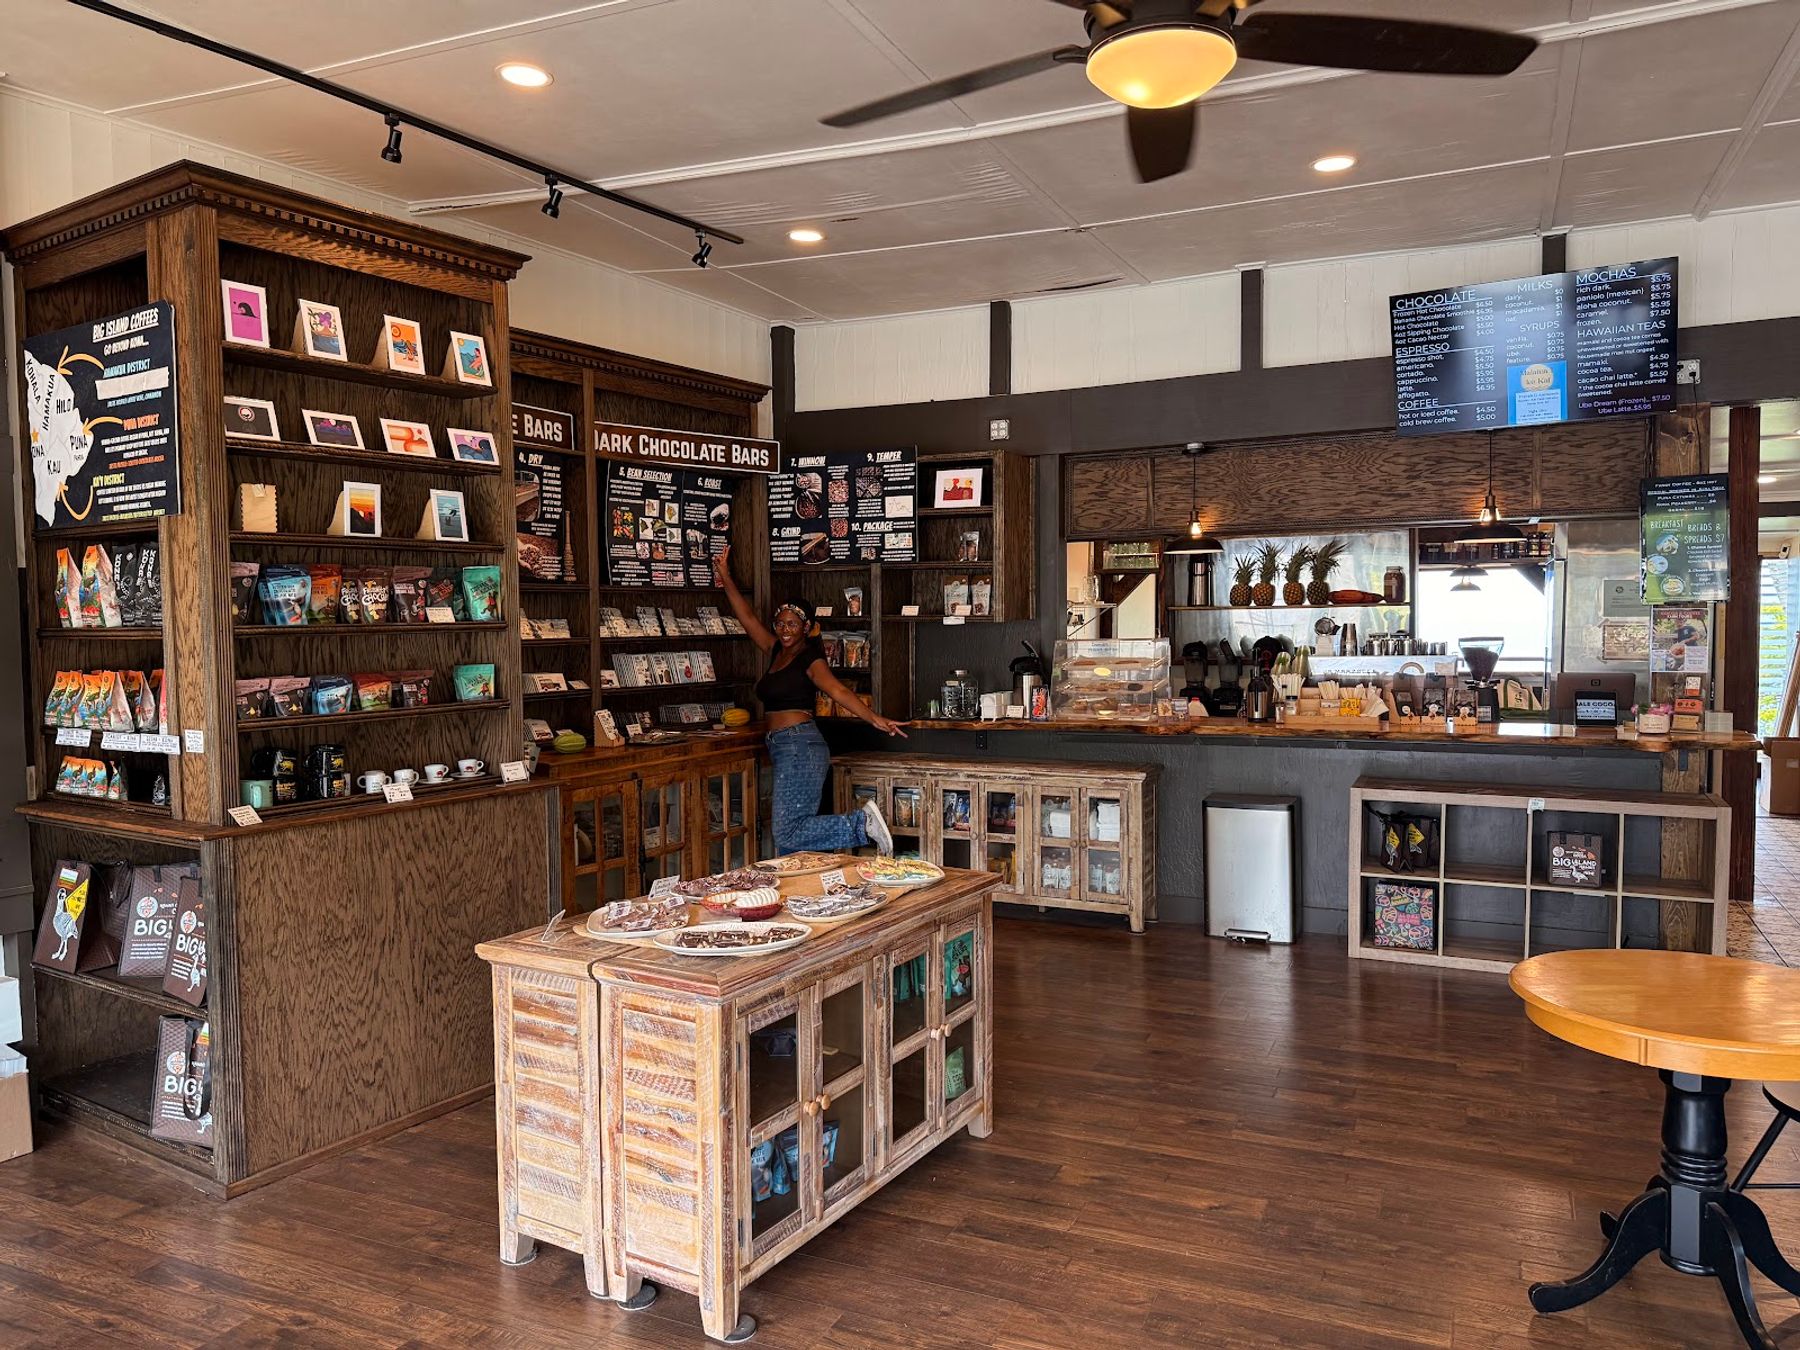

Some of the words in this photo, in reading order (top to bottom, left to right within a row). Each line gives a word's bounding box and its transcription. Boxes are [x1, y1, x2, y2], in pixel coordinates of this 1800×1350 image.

[1576, 267, 1636, 284] MOCHAS
[1518, 280, 1553, 293] MILKS
[1607, 288, 1643, 299] (mexican)
[1396, 290, 1476, 309] CHOCOLATE
[1599, 299, 1632, 307] coconut.
[93, 323, 104, 339] BIG
[106, 317, 129, 336] ISLAND
[130, 308, 159, 330] COFFEES
[1520, 321, 1559, 332] SYRUPS
[1578, 325, 1634, 338] HAWAIIAN
[1637, 320, 1666, 330] TEAS
[1396, 342, 1449, 356] ESPRESSO
[26, 359, 41, 404] KOHALA
[42, 374, 55, 430] HAMAKUA
[56, 399, 71, 414] HILO
[1398, 398, 1439, 410] COFFEE
[524, 413, 562, 442] BARS
[70, 434, 88, 450] PUNA
[32, 445, 44, 458] ONA
[639, 434, 726, 463] CHOCOLATE
[732, 445, 769, 467] BARS
[867, 453, 874, 462] 9.
[876, 451, 902, 462] TEMPER
[528, 454, 543, 465] DRY
[791, 458, 797, 467] 7.
[798, 456, 826, 466] WINNOW
[619, 467, 625, 477] 5.
[627, 468, 643, 479] BEAN
[643, 470, 672, 482] SELECTION
[698, 477, 703, 486] 6.
[772, 528, 779, 536] 8.
[781, 527, 801, 537] GRIND
[851, 522, 861, 531] 10.
[863, 521, 894, 532] PACKAGE
[1552, 858, 1571, 867] BIG
[134, 919, 167, 935] BIG
[176, 934, 198, 955] BIG
[165, 1076, 196, 1095] BIG
